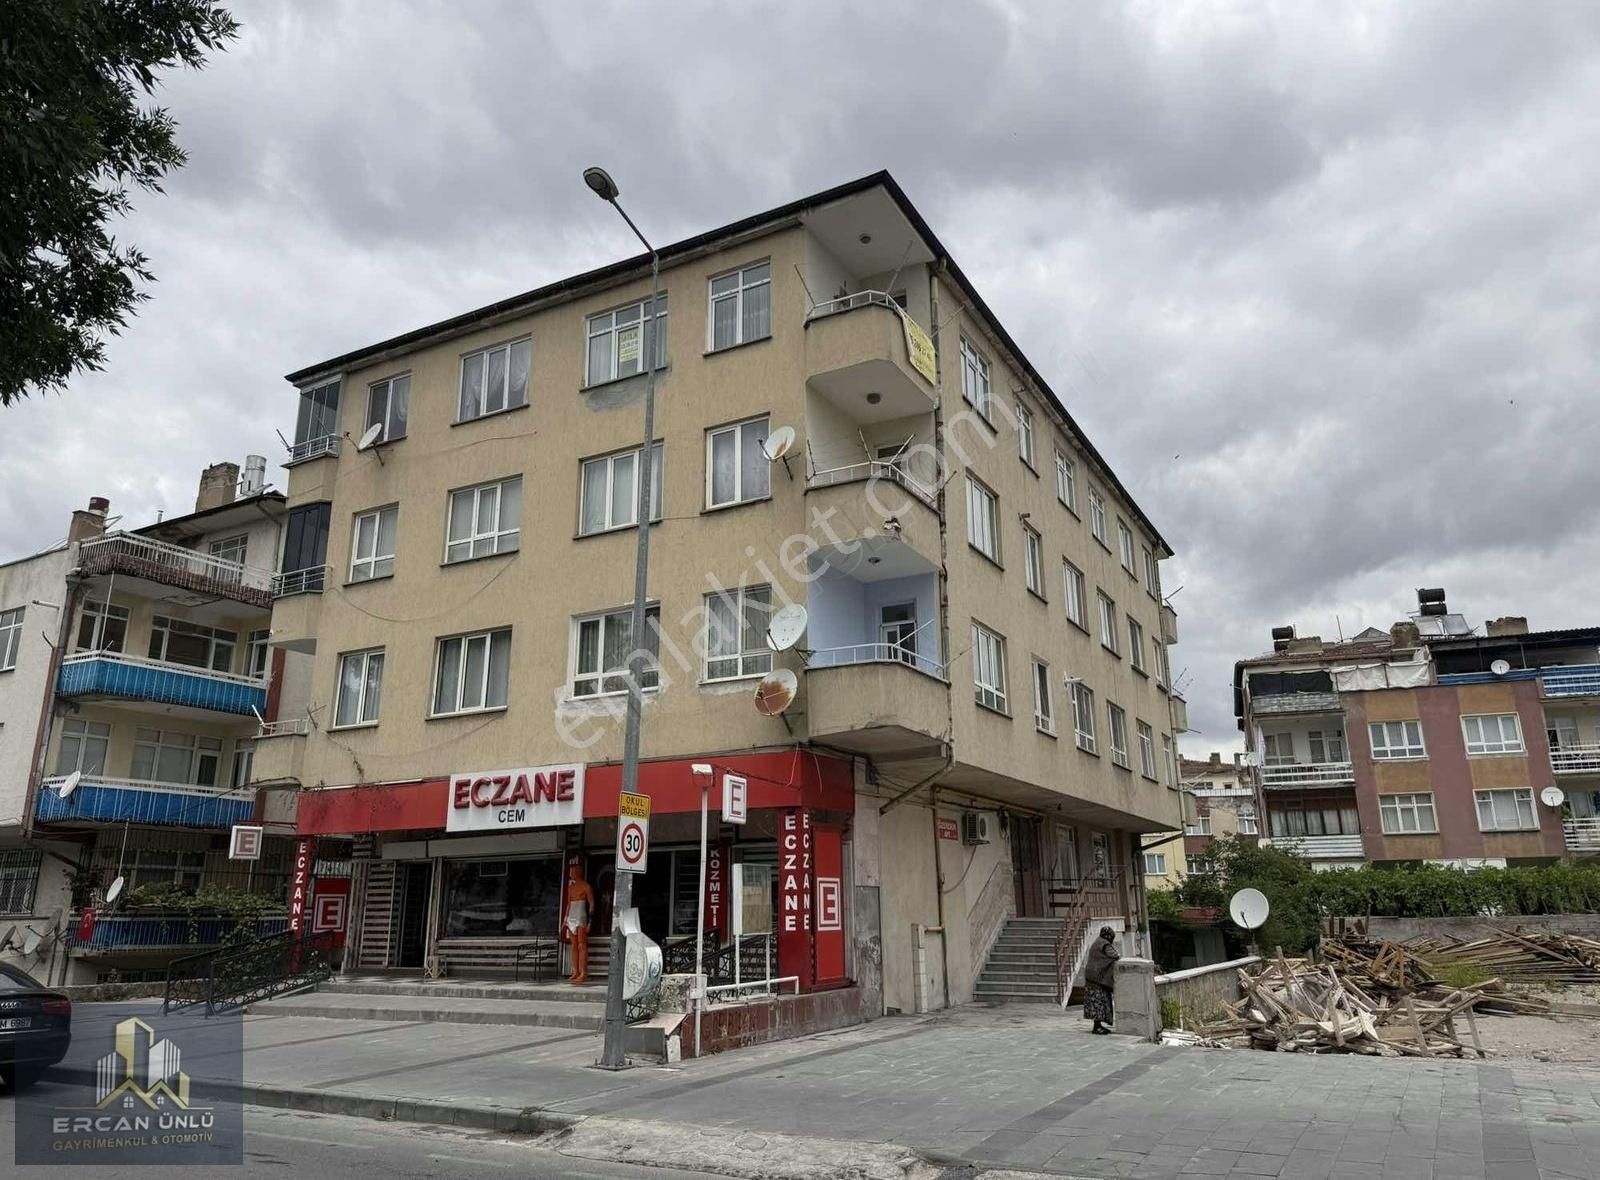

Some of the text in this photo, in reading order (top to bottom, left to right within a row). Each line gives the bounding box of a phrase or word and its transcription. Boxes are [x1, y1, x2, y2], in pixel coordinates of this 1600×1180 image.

[454, 769, 575, 809] ECZANE
[626, 796, 643, 807] OKUL
[731, 784, 742, 815] E
[498, 809, 525, 823] CEM
[239, 833, 255, 852] E
[625, 834, 640, 852] 30
[291, 842, 308, 930] ECZANE
[784, 815, 798, 931] ECZANE
[709, 848, 721, 936] KOZMETİ
